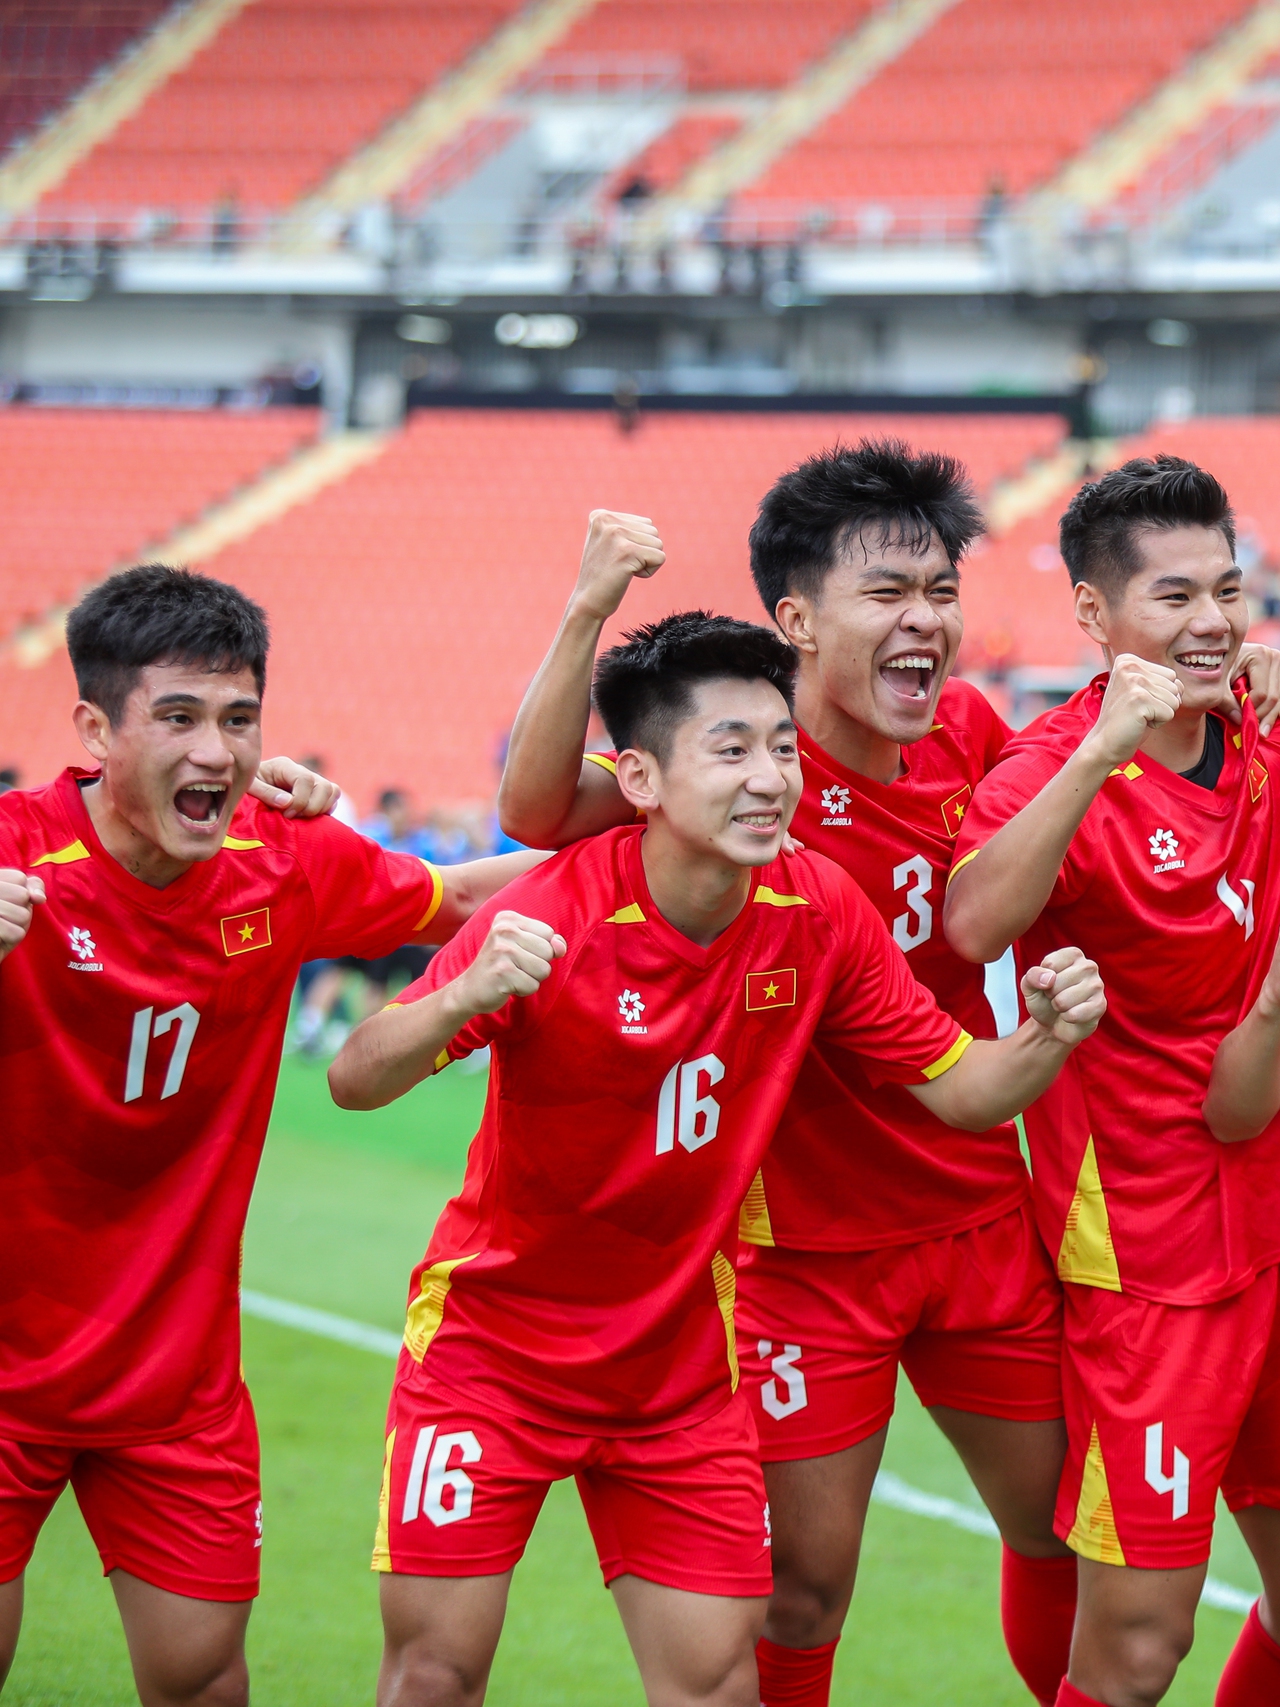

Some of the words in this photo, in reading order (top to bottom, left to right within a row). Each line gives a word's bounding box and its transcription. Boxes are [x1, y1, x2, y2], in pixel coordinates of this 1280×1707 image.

[892, 853, 934, 954] 3
[124, 1001, 201, 1104] 17
[655, 1052, 726, 1157] 16
[757, 1338, 808, 1422] 3
[401, 1423, 484, 1528] 16
[1144, 1420, 1190, 1522] 4
